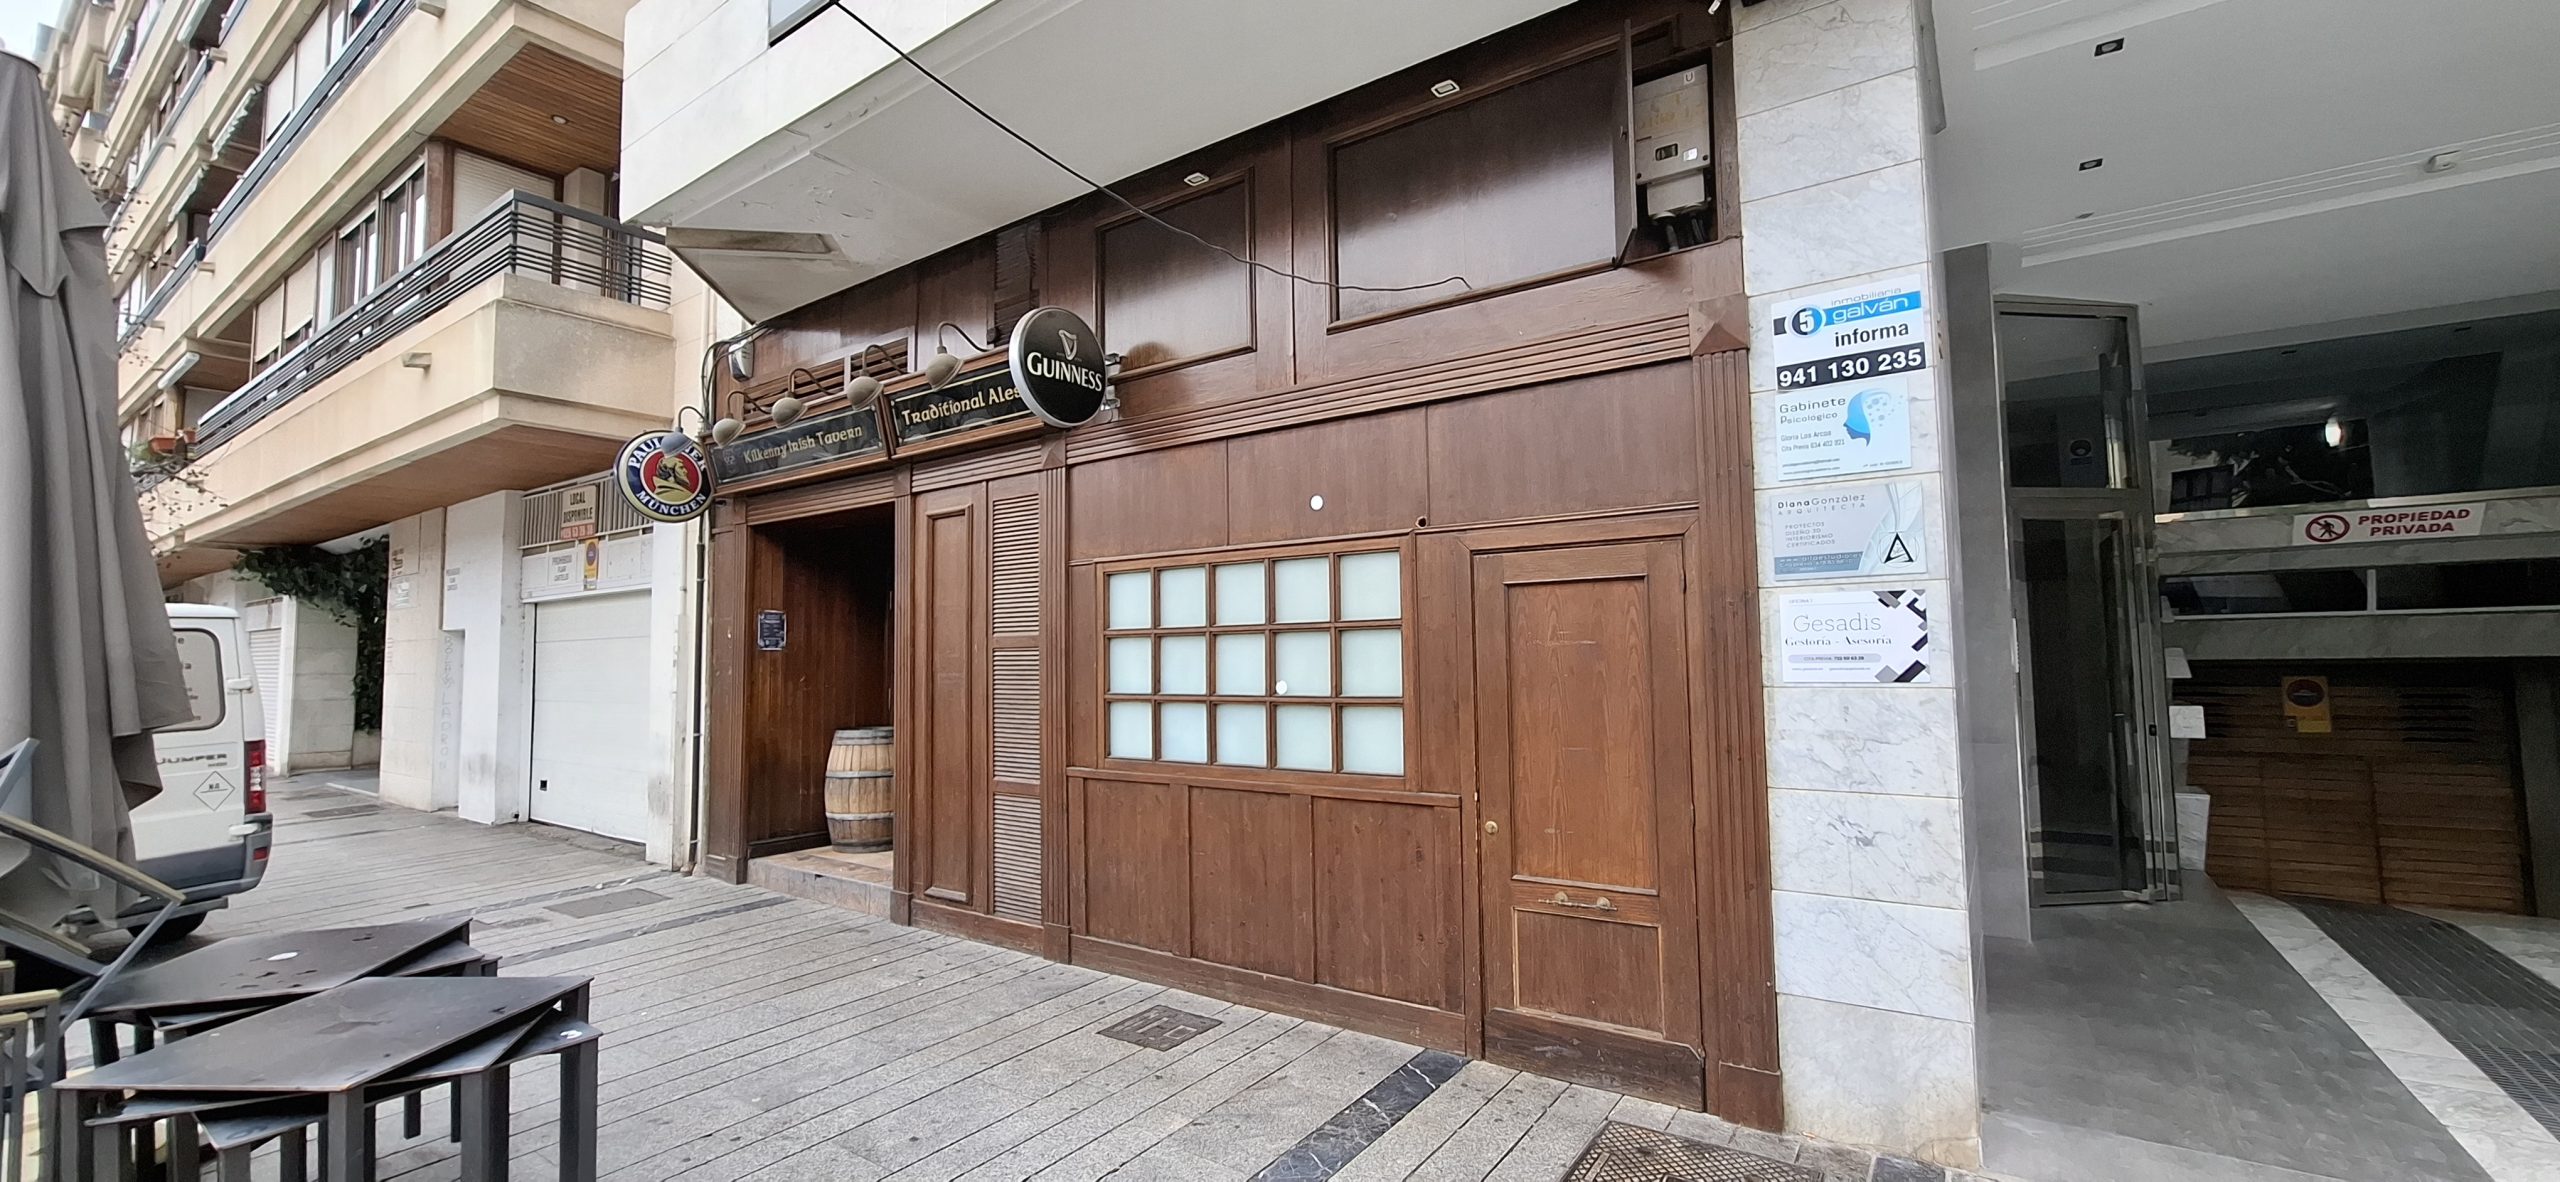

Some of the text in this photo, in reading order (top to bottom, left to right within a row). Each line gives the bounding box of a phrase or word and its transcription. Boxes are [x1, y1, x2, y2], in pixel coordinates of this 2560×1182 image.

[1831, 287, 1902, 306] inmobiliaria
[1833, 297, 1909, 324] galván
[1799, 310, 1815, 333] 5
[1835, 322, 1909, 347] informa
[1027, 352, 1103, 392] GUINNESS
[1779, 348, 1922, 387] 941 130 235
[902, 386, 1021, 425] Traditional Ales
[1779, 397, 1846, 414] Gabinete
[743, 426, 863, 464] Kilkenny Irish Tavern
[1780, 434, 1799, 442] Gloria
[1813, 430, 1832, 438] Arcos
[569, 491, 586, 506] LOCAL
[563, 506, 593, 524] DISPONIBLE
[1778, 502, 1866, 516] ARQUITECTA
[2358, 508, 2471, 526] PROPIEDAD
[2370, 521, 2455, 537] PRIVADA
[1793, 612, 1881, 633] Gesadis
[157, 753, 228, 766] JUMPER
